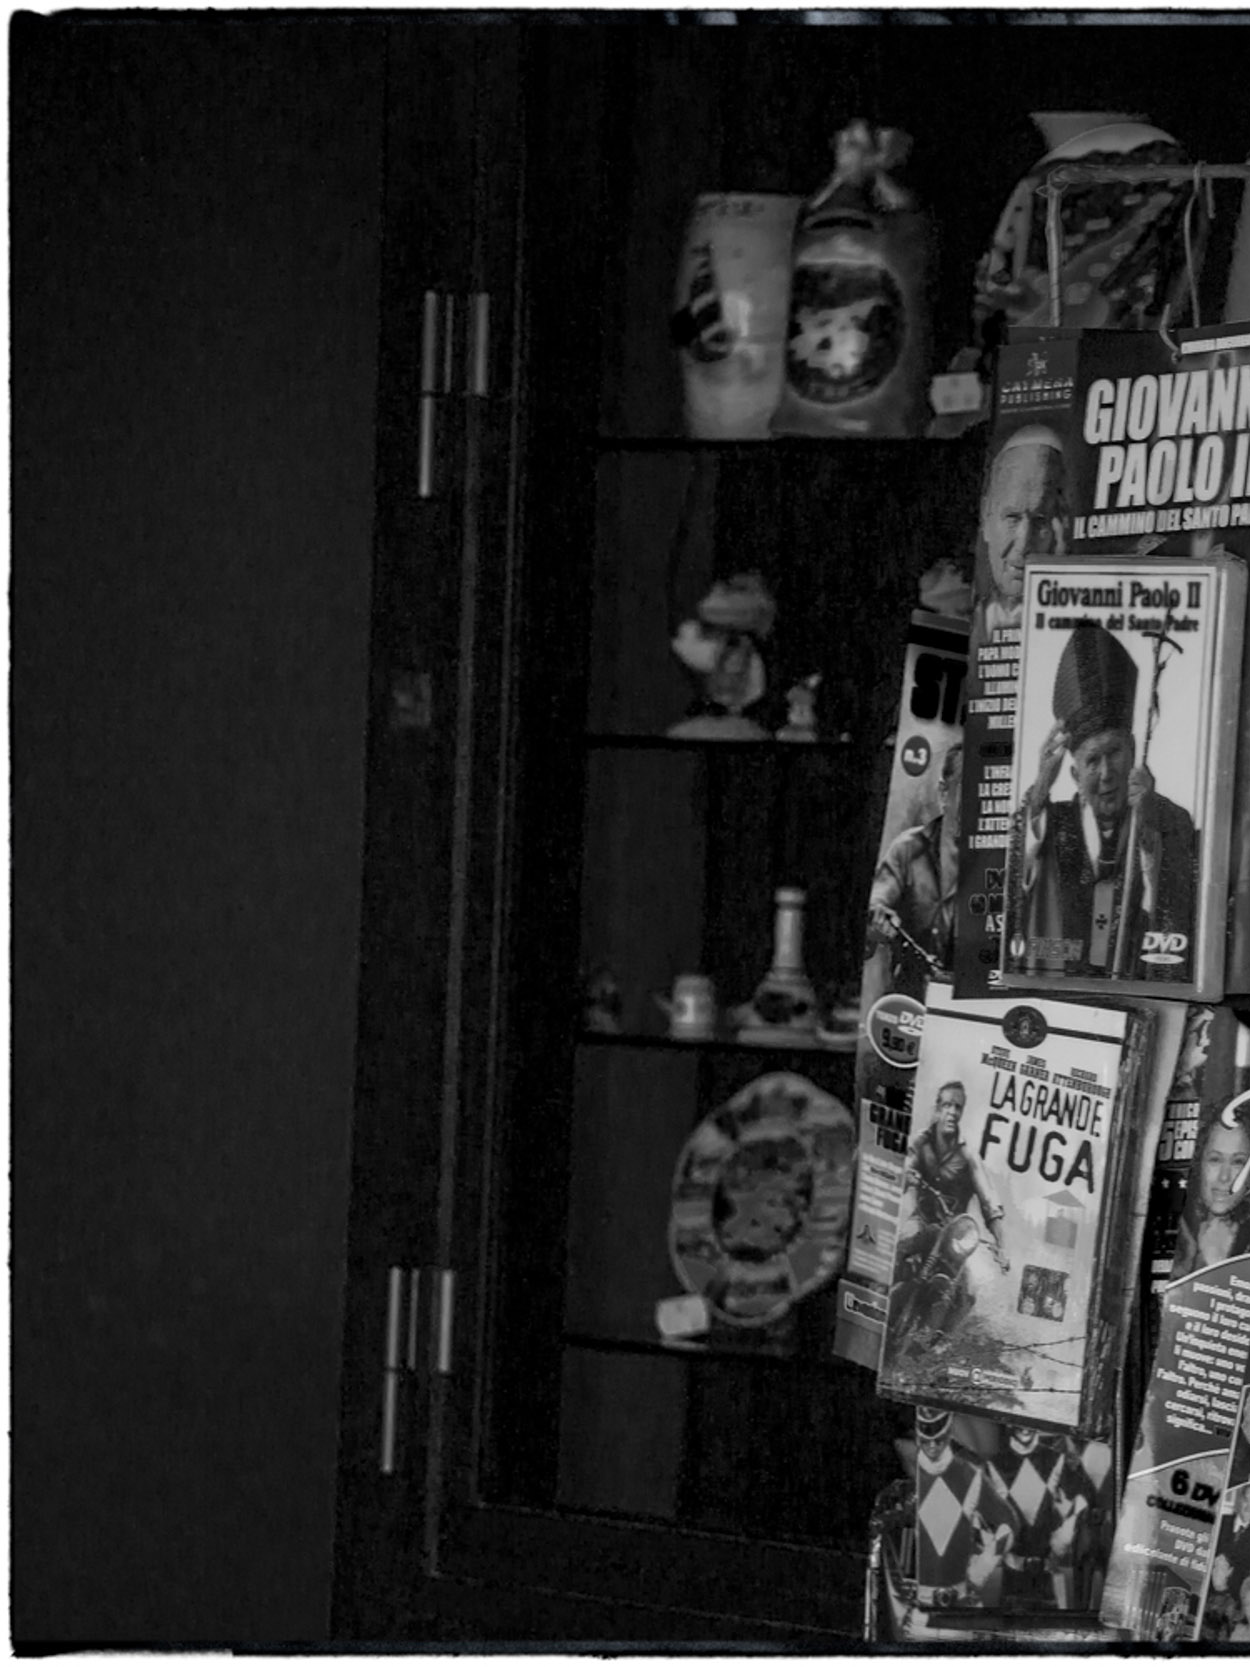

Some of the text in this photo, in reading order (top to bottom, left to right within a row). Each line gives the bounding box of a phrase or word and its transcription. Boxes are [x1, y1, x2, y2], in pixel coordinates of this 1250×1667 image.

[1092, 434, 1226, 510] PAOLO
[1087, 508, 1156, 539] CAMMINO
[1182, 504, 1230, 531] SANTO
[1036, 579, 1202, 609] Giovanni Paolo II
[1105, 614, 1124, 631] del
[1128, 614, 1163, 632] Santo
[1141, 930, 1189, 954] DVD
[990, 1071, 1016, 1112] LA
[1019, 1079, 1104, 1138] GRANDE
[980, 1112, 1095, 1195] FUGA
[1170, 1468, 1190, 1496] 6
